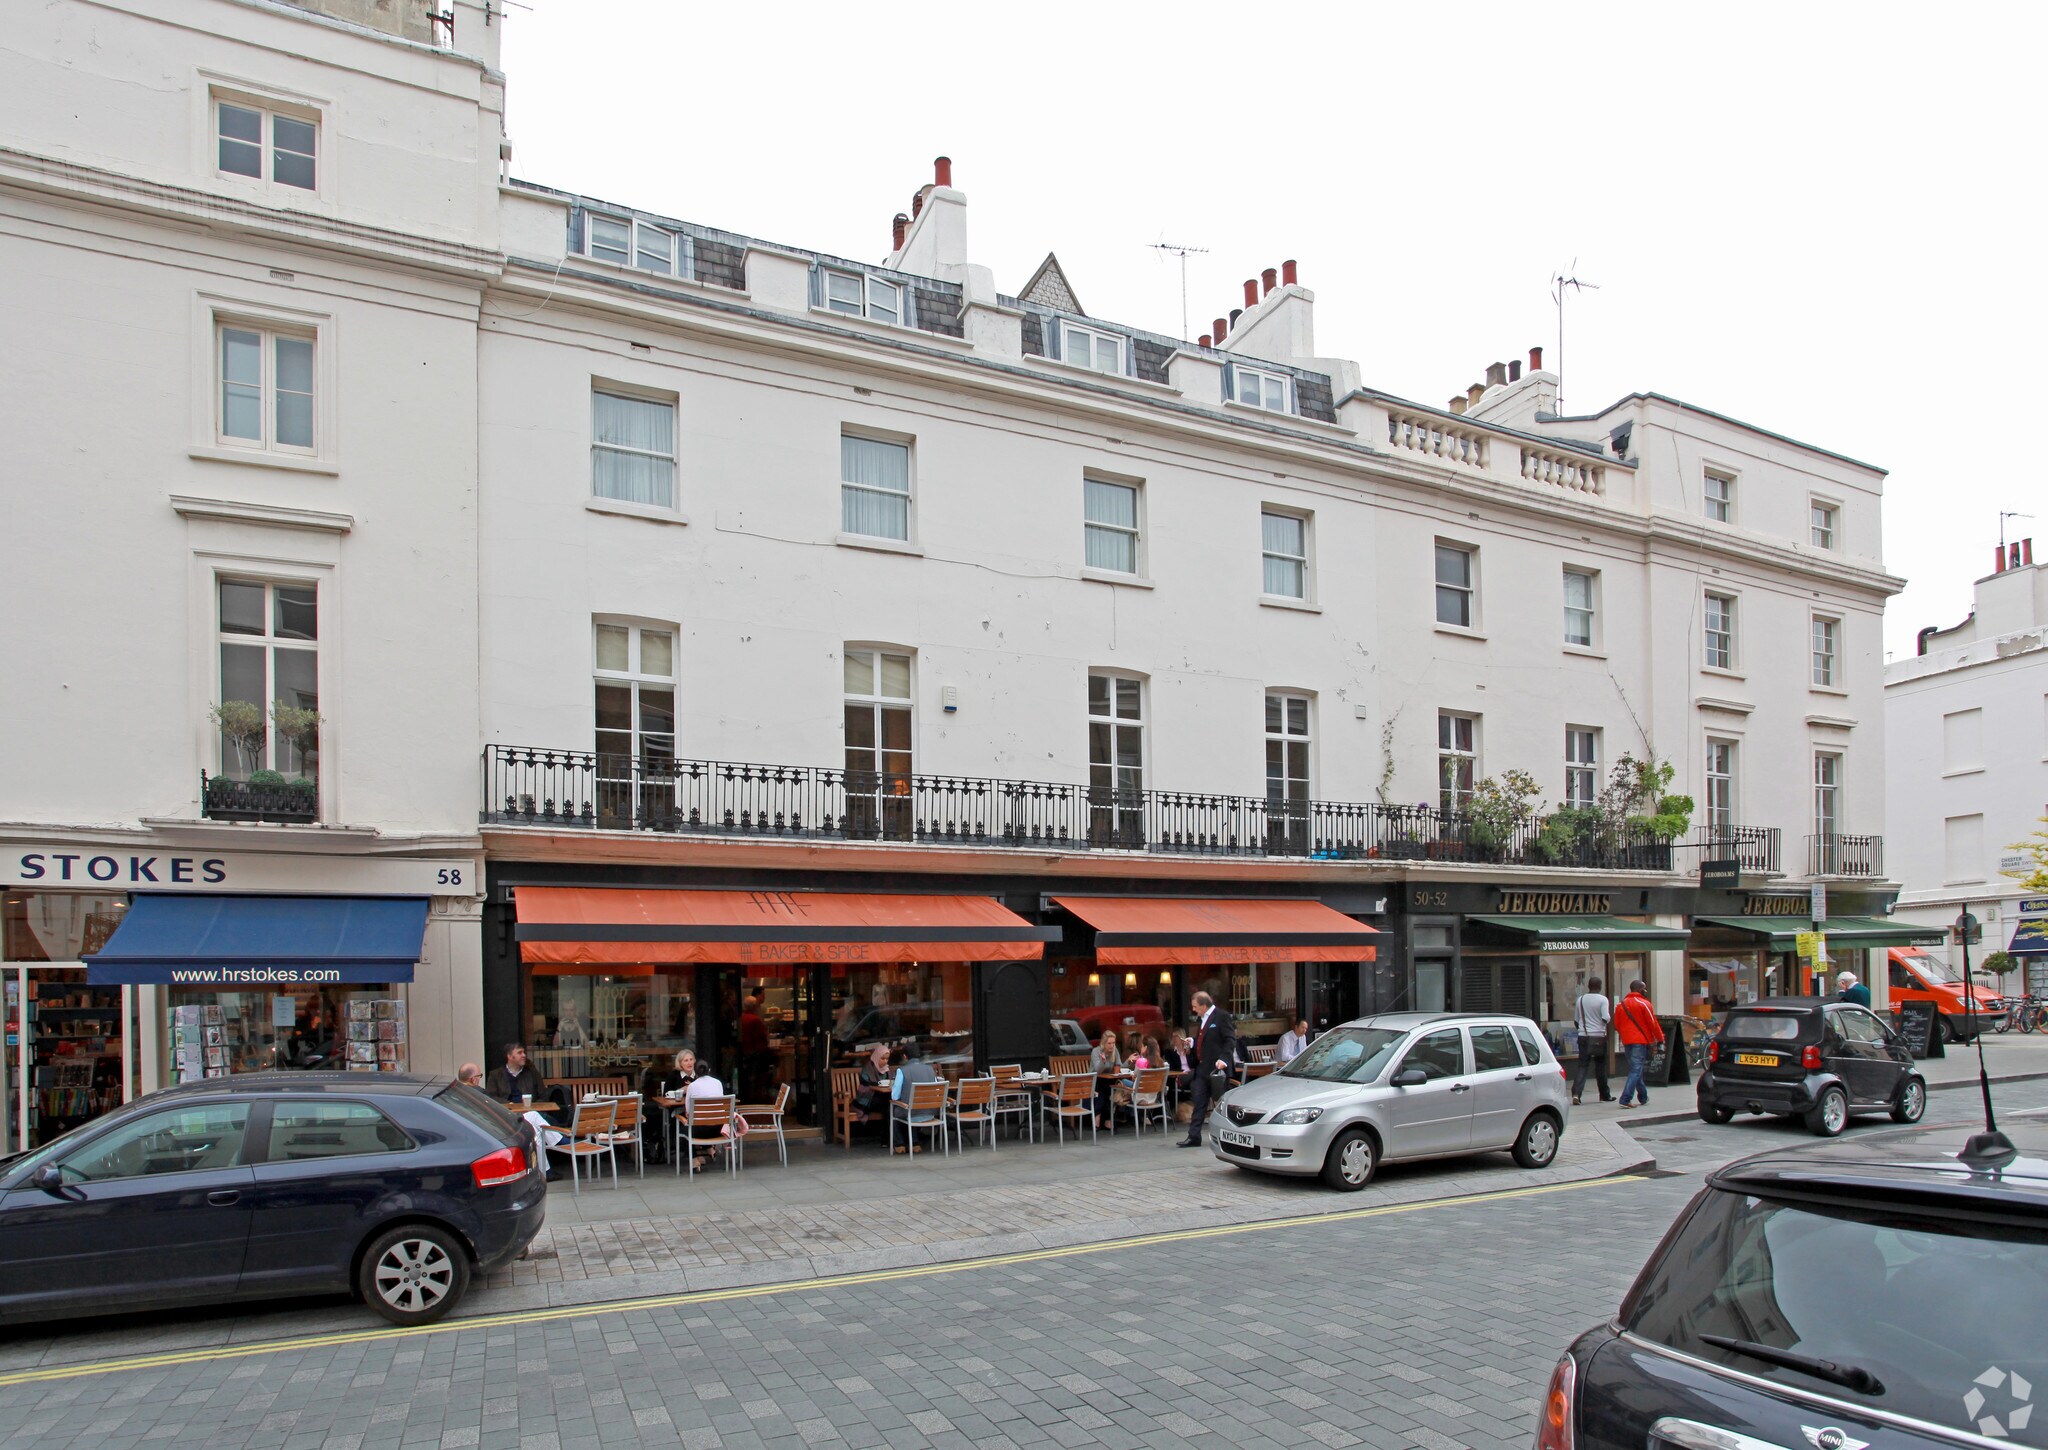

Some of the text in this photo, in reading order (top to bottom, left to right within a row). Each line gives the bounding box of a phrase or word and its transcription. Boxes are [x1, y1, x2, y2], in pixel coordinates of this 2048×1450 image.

[20, 854, 226, 883] STOKES
[438, 869, 461, 885] 58
[1414, 891, 1448, 906] 50-52
[1499, 893, 1611, 913] JEROBOAMS
[1743, 896, 1812, 915] JEROBOA
[760, 944, 869, 960] BAKER & SPICE
[1543, 941, 1589, 950] JEROBOAMS
[1213, 948, 1293, 961] BAKER & SPICE
[172, 967, 340, 982] www.hrstokes.com
[1819, 1434, 1842, 1446] MINI
